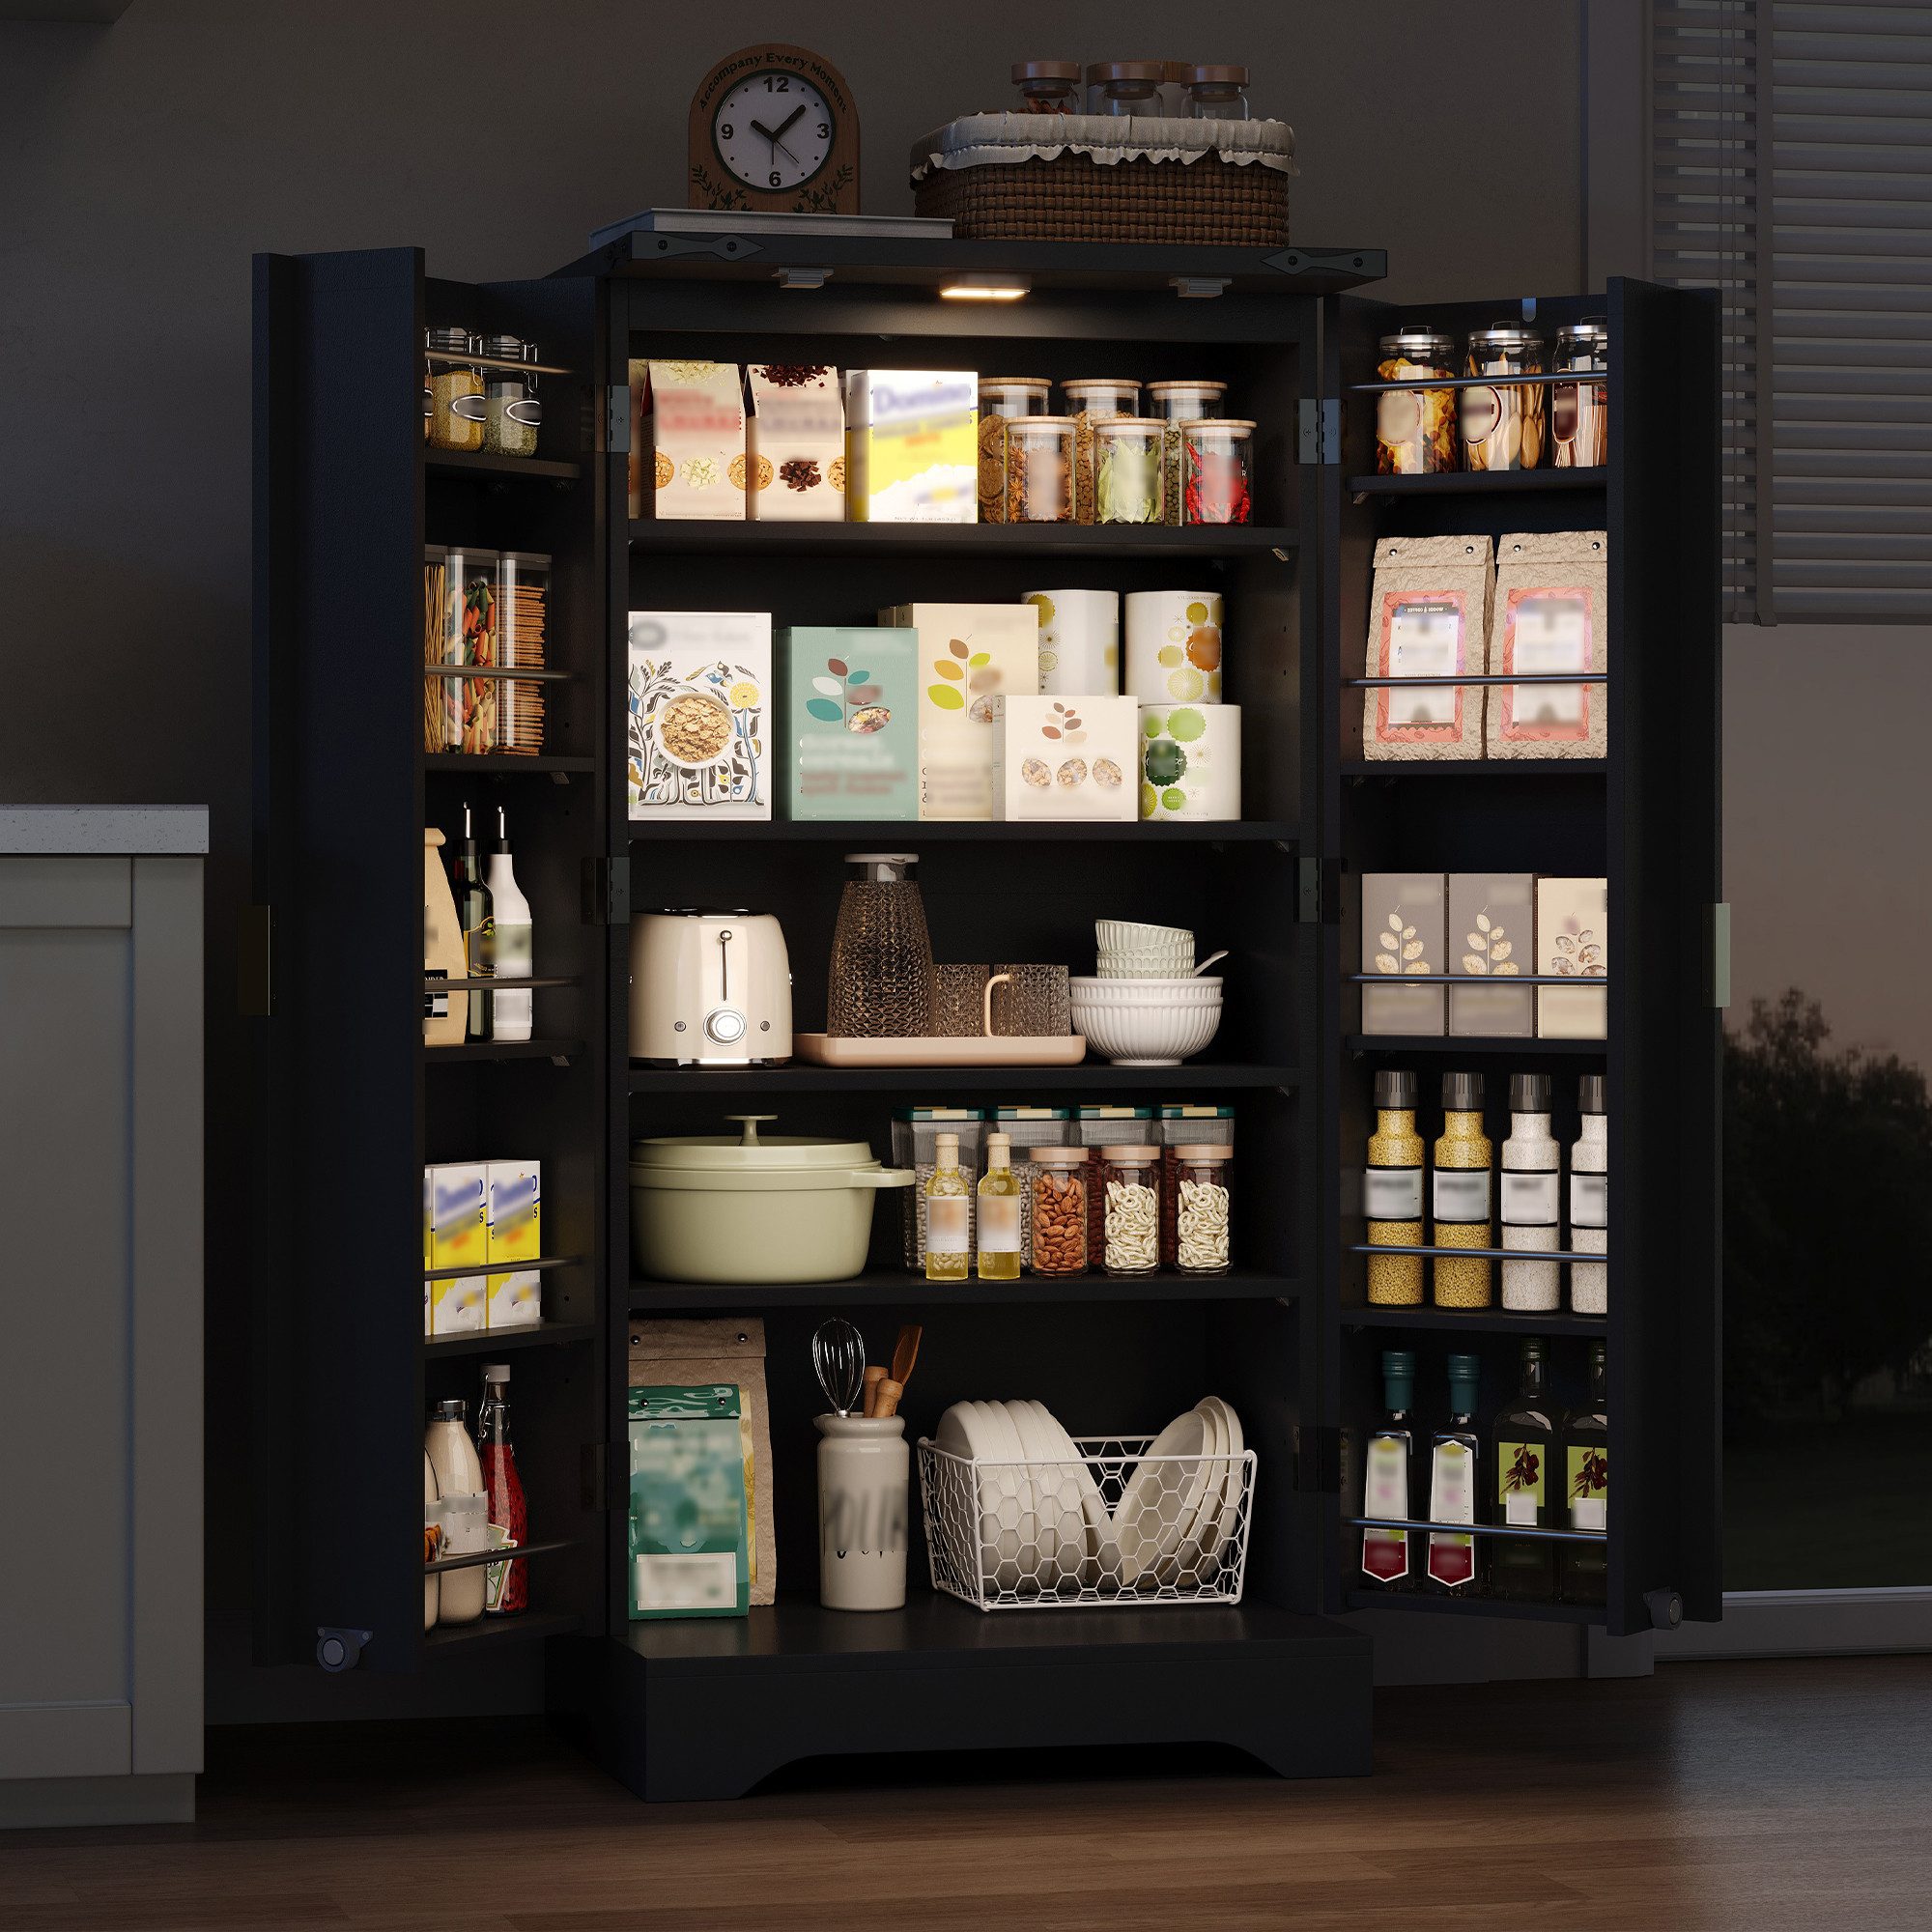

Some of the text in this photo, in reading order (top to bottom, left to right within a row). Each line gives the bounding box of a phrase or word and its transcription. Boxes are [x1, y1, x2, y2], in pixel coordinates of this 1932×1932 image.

[699, 52, 847, 114] Accompany Every Moment
[763, 76, 789, 93] 12
[721, 124, 734, 140] 9
[816, 123, 830, 139] 3
[768, 171, 782, 187] 6
